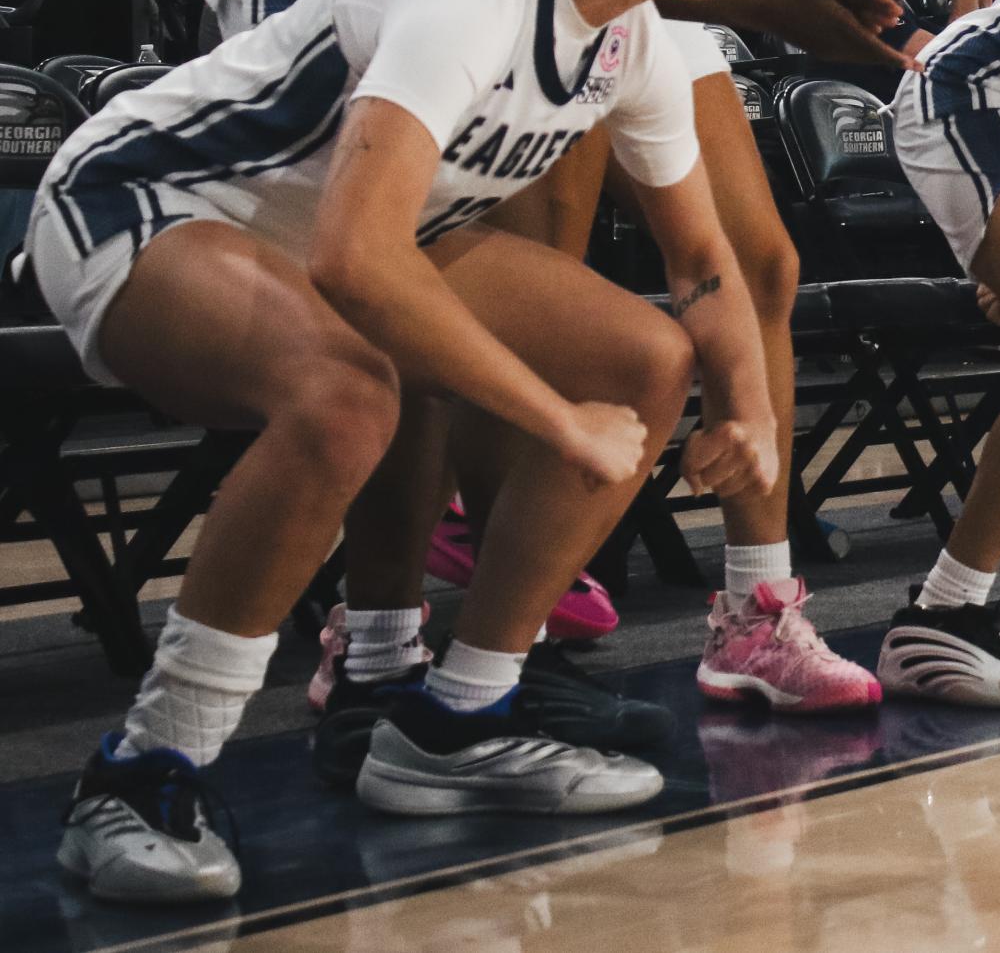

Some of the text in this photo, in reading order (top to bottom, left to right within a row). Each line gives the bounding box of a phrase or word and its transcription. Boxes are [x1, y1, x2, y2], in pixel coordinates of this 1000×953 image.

[842, 130, 883, 142] GEORGIA
[0, 140, 61, 154] OUTHERN
[843, 142, 884, 153] SOUTHERN
